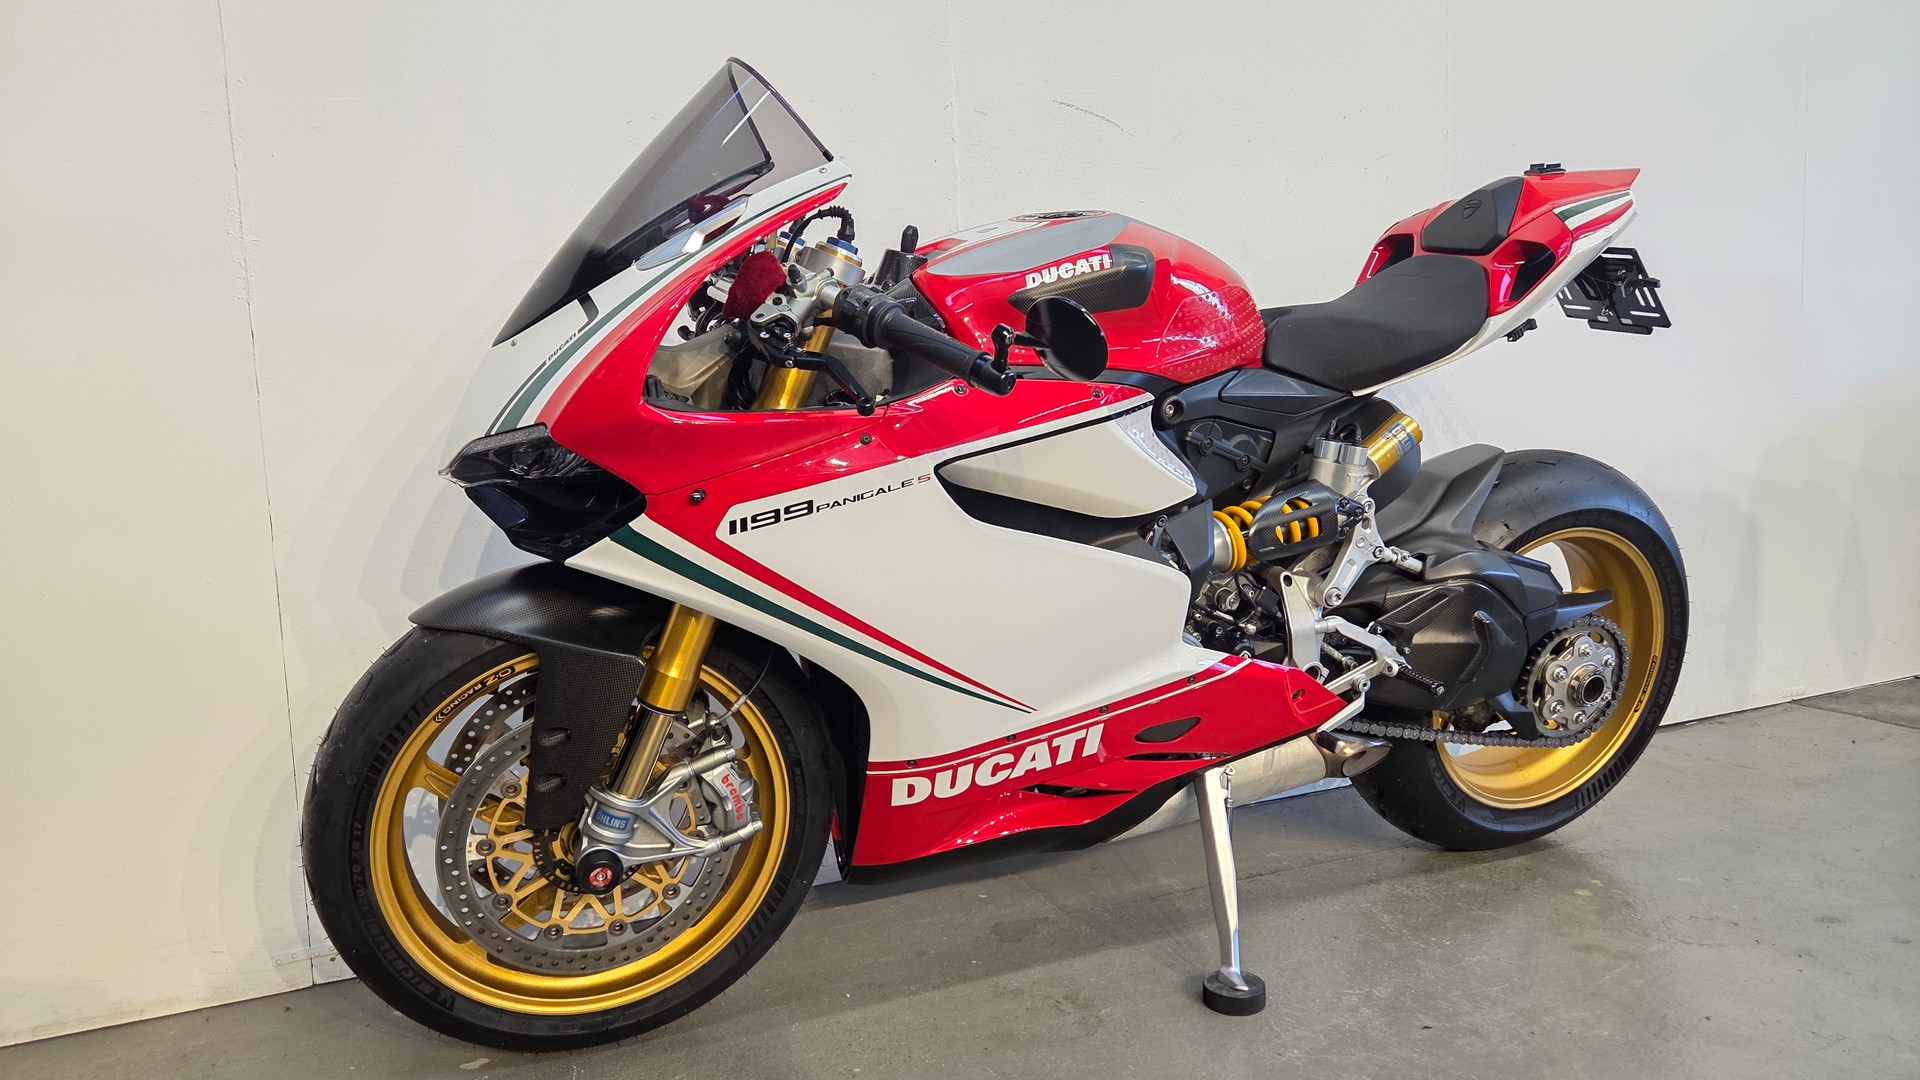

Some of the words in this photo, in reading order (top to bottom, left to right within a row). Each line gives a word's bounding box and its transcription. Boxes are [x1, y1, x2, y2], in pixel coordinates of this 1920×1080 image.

[1025, 254, 1113, 290] DUCATI
[547, 332, 577, 362] DUCATI
[728, 499, 814, 536] 1199
[815, 478, 915, 513] PANIGALE
[917, 473, 931, 485] S
[442, 683, 482, 715] RACING
[890, 723, 1105, 807] DUCATI
[721, 773, 745, 823] brembo
